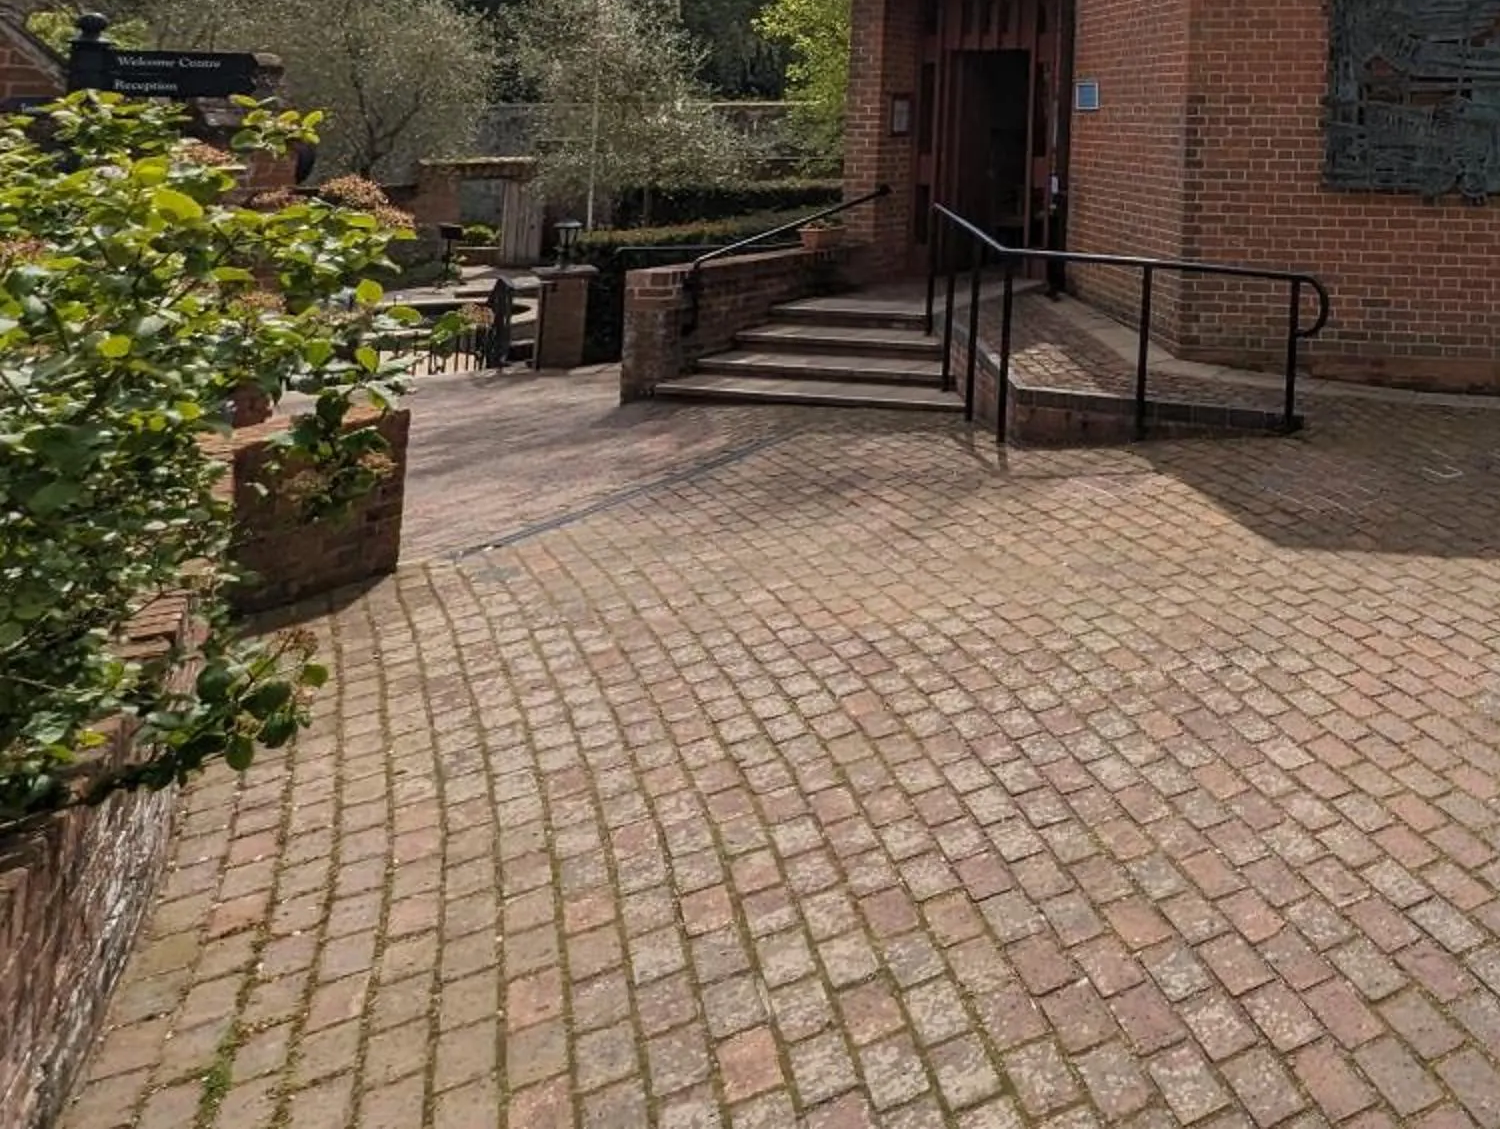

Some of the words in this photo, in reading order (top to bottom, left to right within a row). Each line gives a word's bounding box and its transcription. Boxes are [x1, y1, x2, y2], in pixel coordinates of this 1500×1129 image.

[117, 56, 175, 68] Welcome
[179, 57, 222, 69] Centre
[113, 78, 178, 92] Reception
